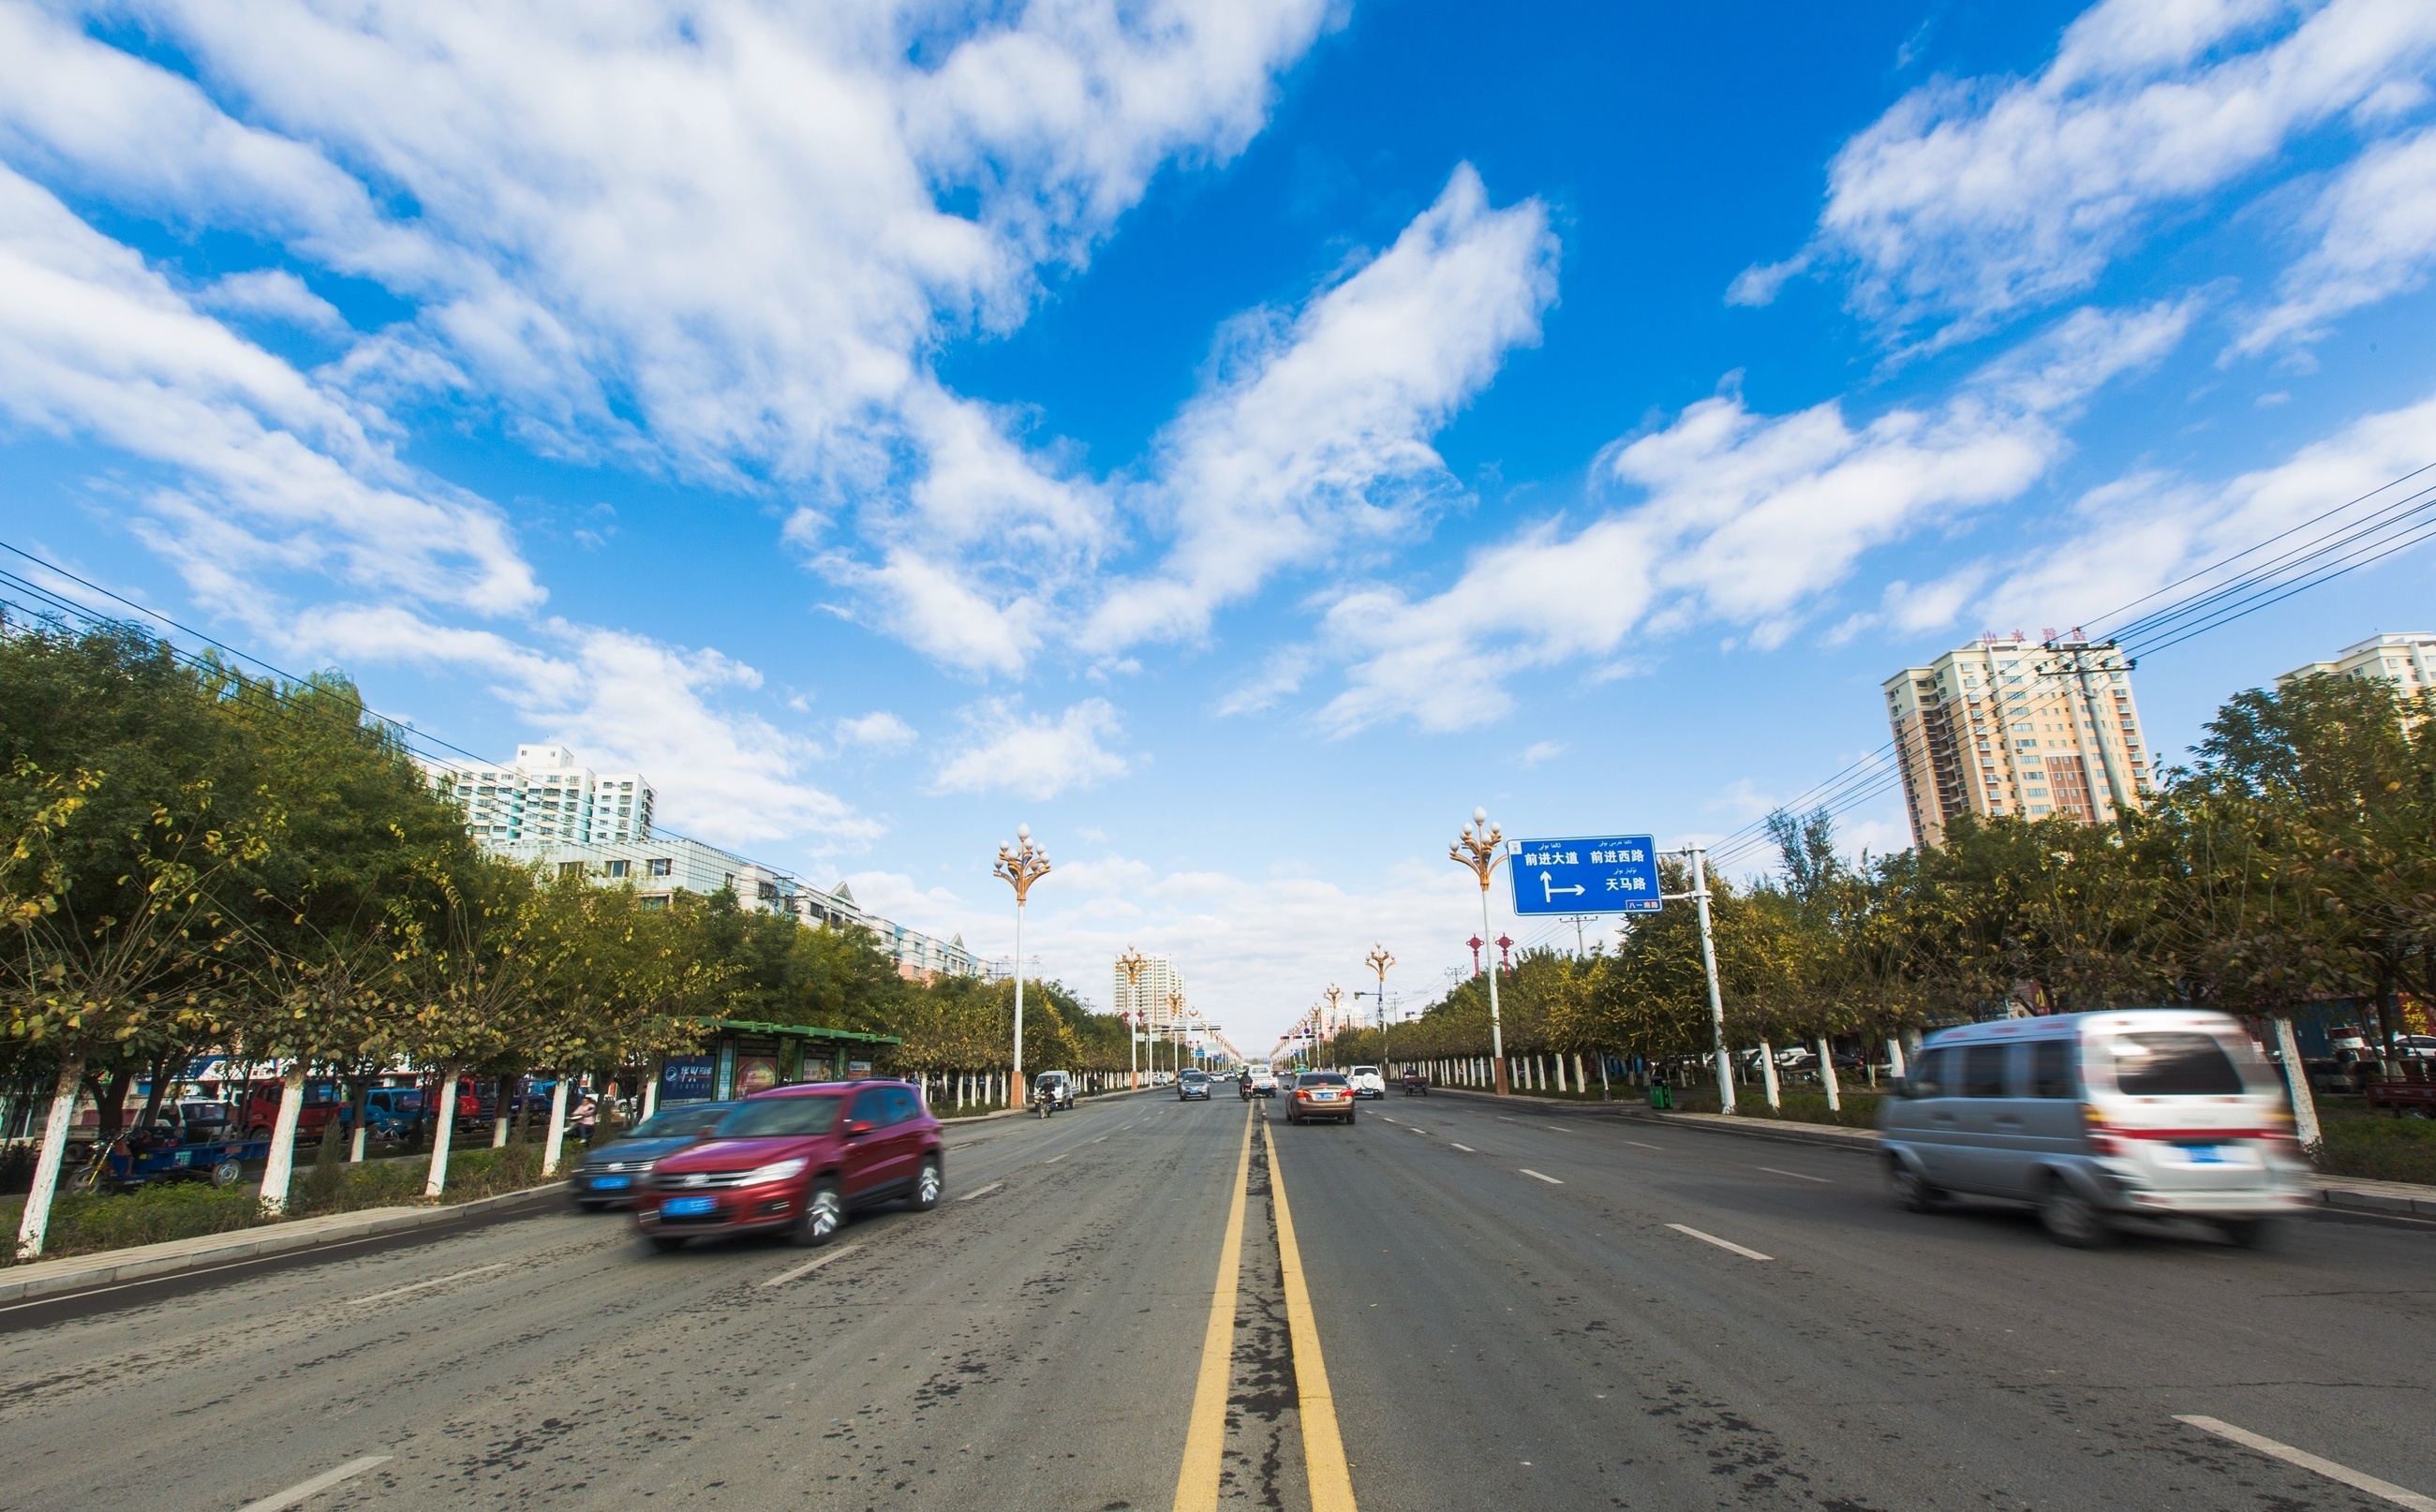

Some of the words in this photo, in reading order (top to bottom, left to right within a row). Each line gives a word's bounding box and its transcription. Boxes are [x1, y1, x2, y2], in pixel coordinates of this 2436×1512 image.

[1524, 852, 1579, 866] 前进大道
[1590, 850, 1644, 864] 前进西路
[1606, 877, 1645, 891] 天马路
